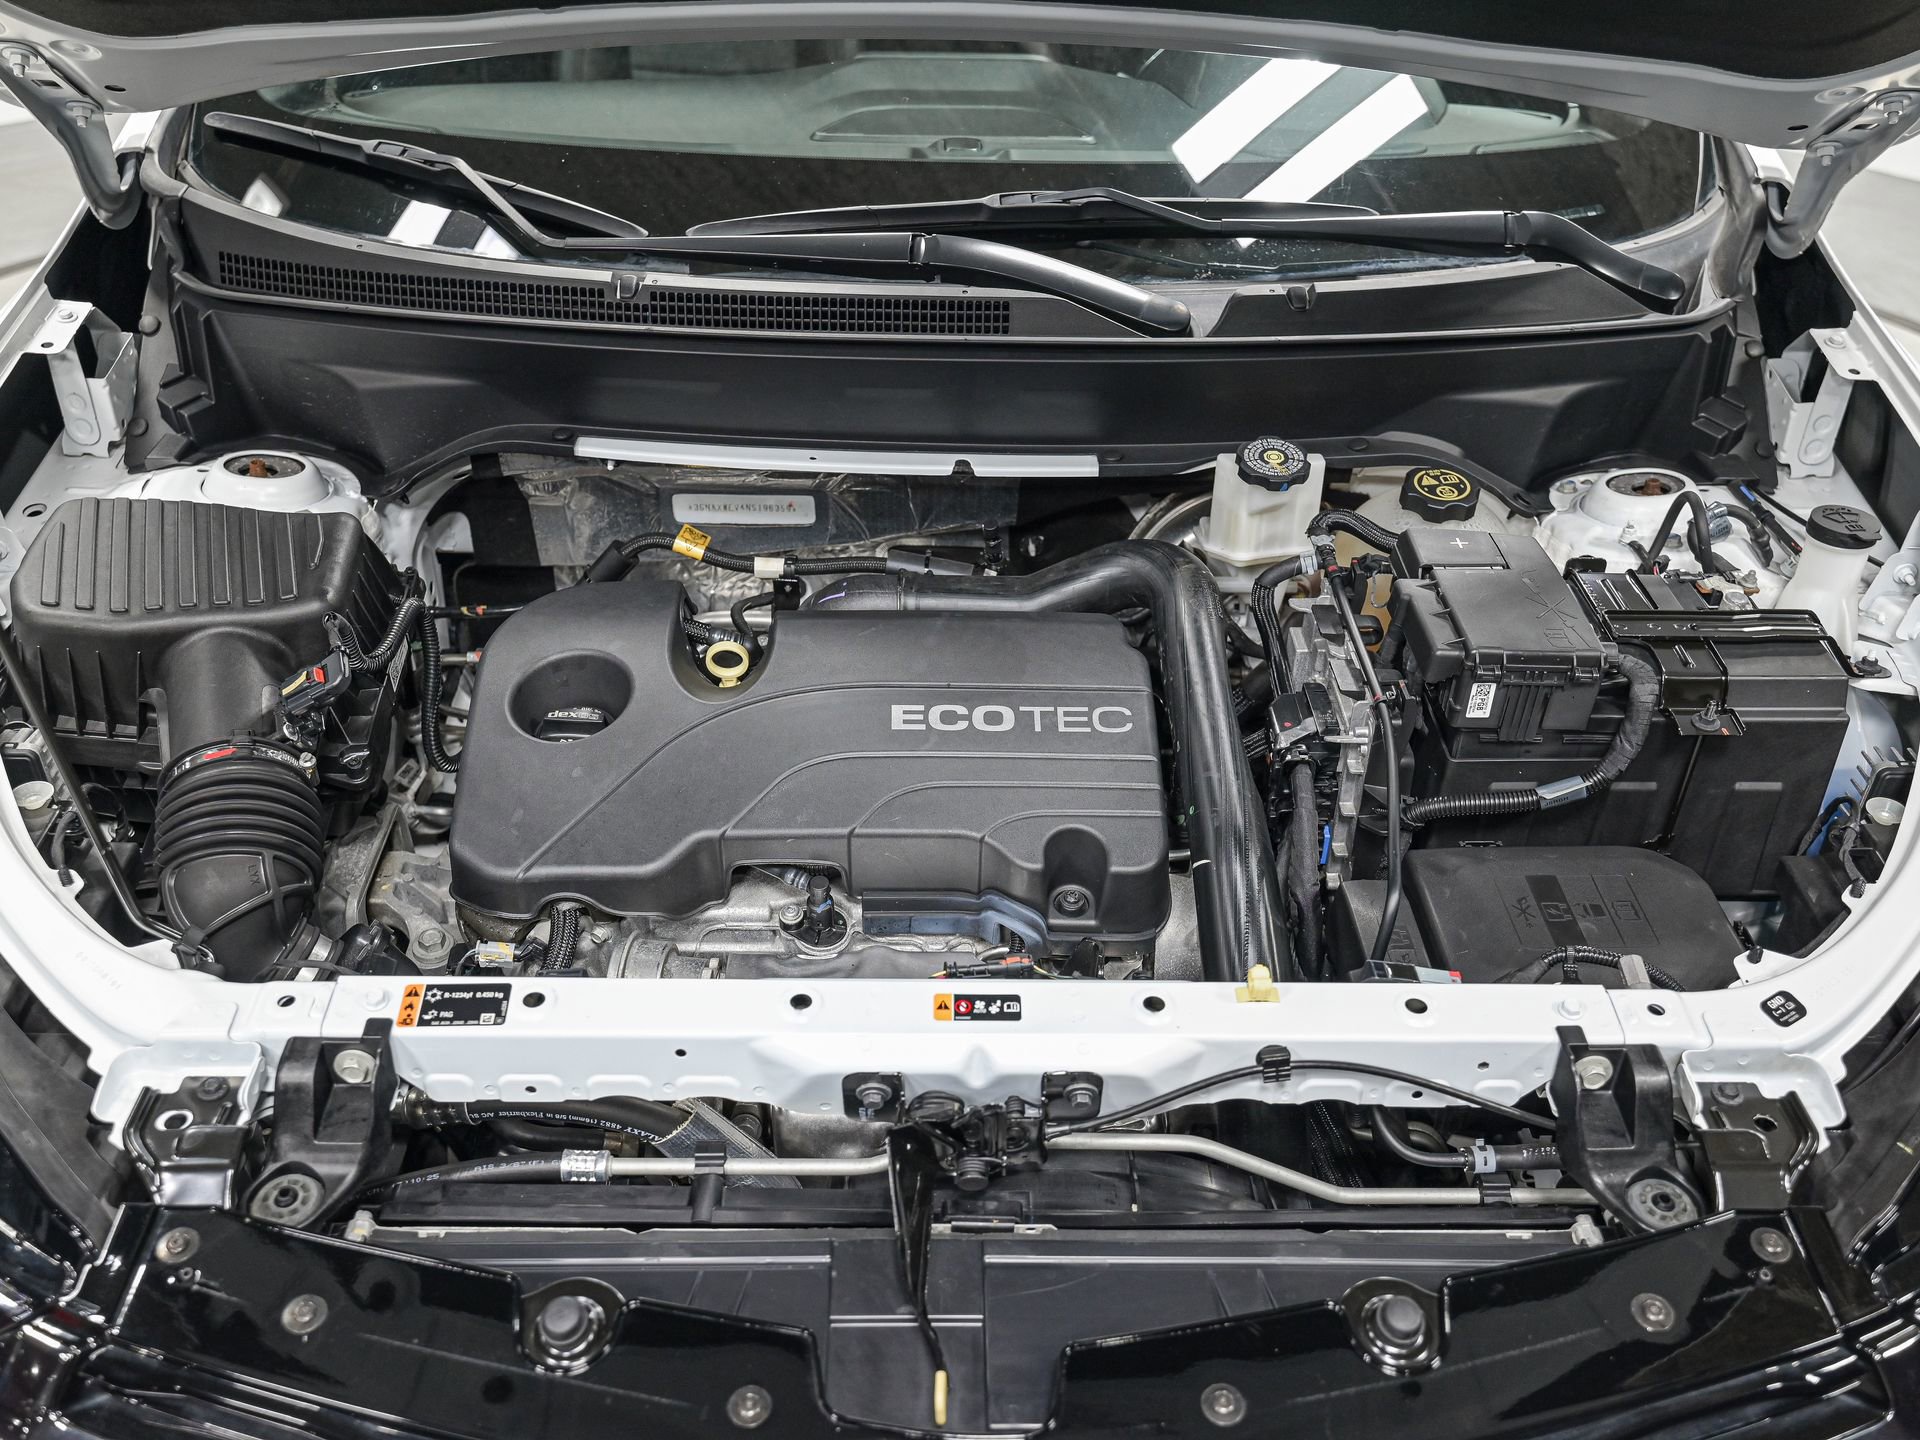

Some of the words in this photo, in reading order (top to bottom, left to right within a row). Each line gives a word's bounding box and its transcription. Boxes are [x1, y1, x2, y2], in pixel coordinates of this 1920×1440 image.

[547, 710, 599, 720] dexos
[891, 704, 1134, 733] ECOTEC
[495, 991, 504, 999] kg
[1766, 995, 1786, 1009] GND
[498, 1110, 543, 1119] Flexbarrier
[568, 1114, 598, 1125] (16mm)
[600, 1120, 622, 1130] 4882
[623, 1126, 662, 1141] ALAXY
